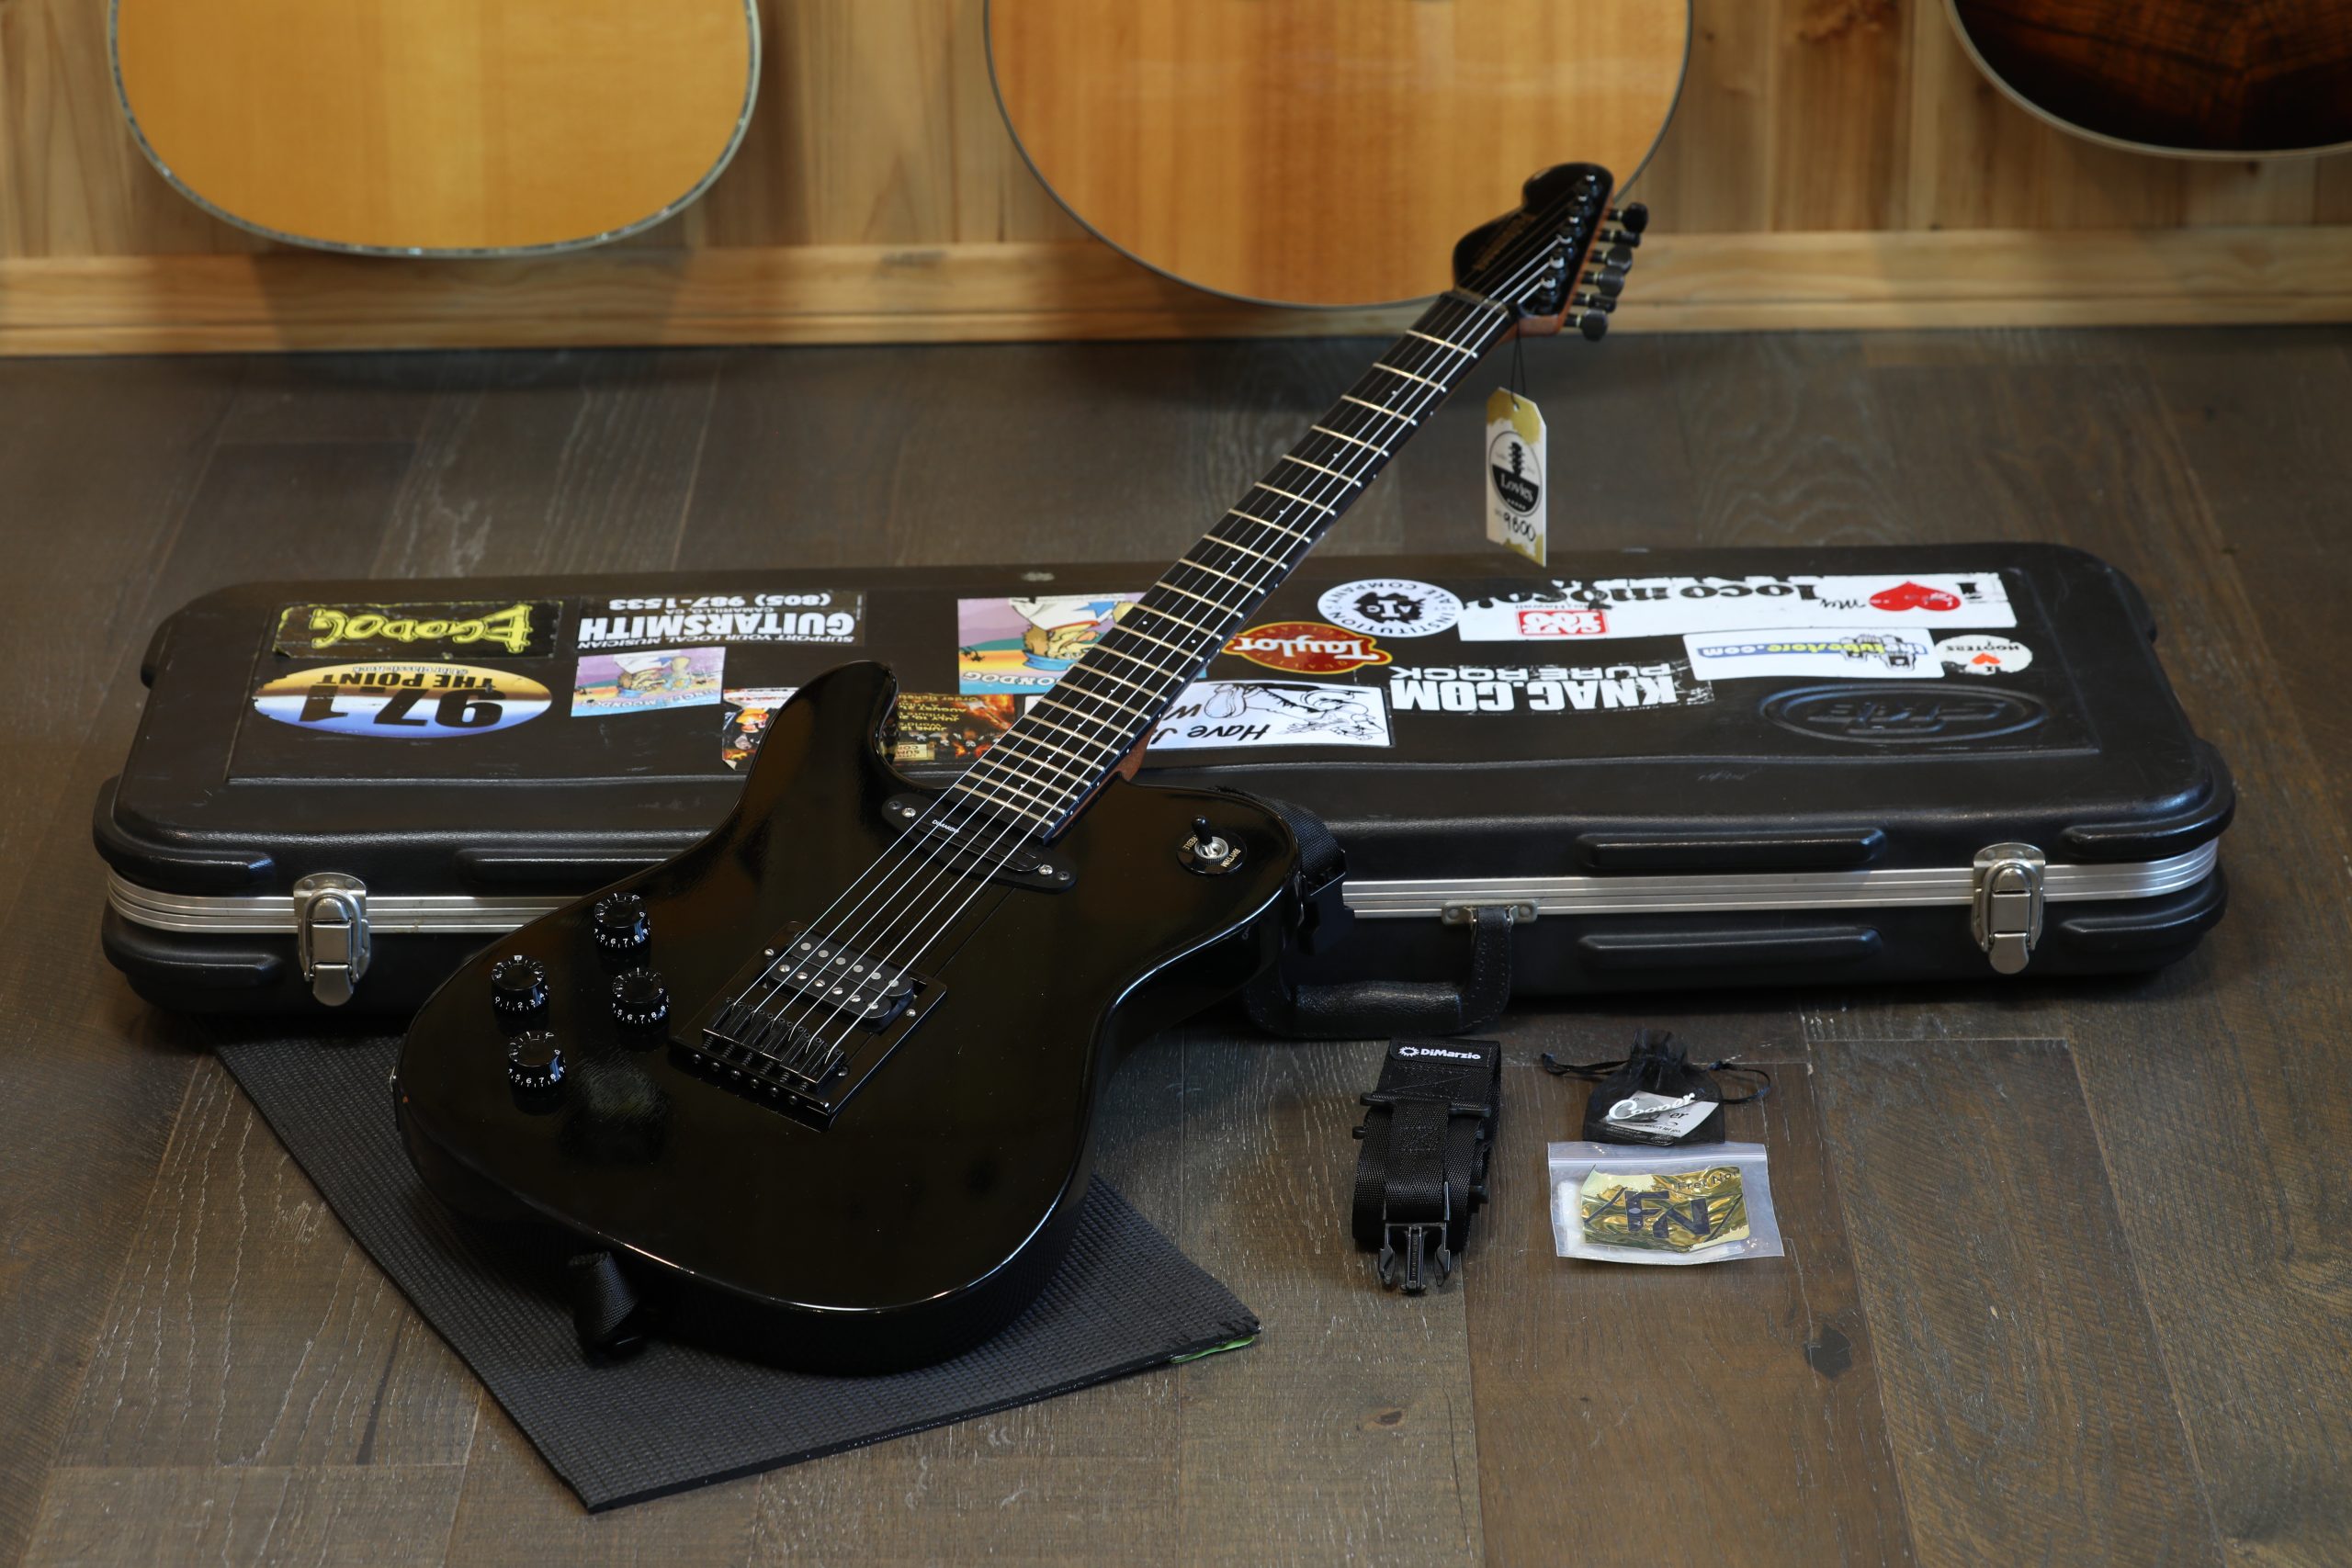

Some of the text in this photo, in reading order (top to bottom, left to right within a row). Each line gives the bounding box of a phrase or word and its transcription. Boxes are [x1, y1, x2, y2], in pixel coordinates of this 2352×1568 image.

[1500, 472, 1534, 502] Lovies
[608, 592, 831, 611] (805) 987-1533
[307, 604, 534, 654] EGODOG
[577, 613, 855, 642] GUITARSMITH
[577, 634, 855, 649] SUPPORT YOUR LOCAL MUSICIAN
[316, 673, 498, 690] THE POINT
[962, 671, 1059, 686] ONDOG
[1389, 662, 1672, 682] PURE ROCK
[1390, 676, 1679, 712] KNAC.COM
[298, 684, 507, 729] 97.1
[1187, 724, 1272, 742] Have
[1419, 1047, 1482, 1060] DiMarzio
